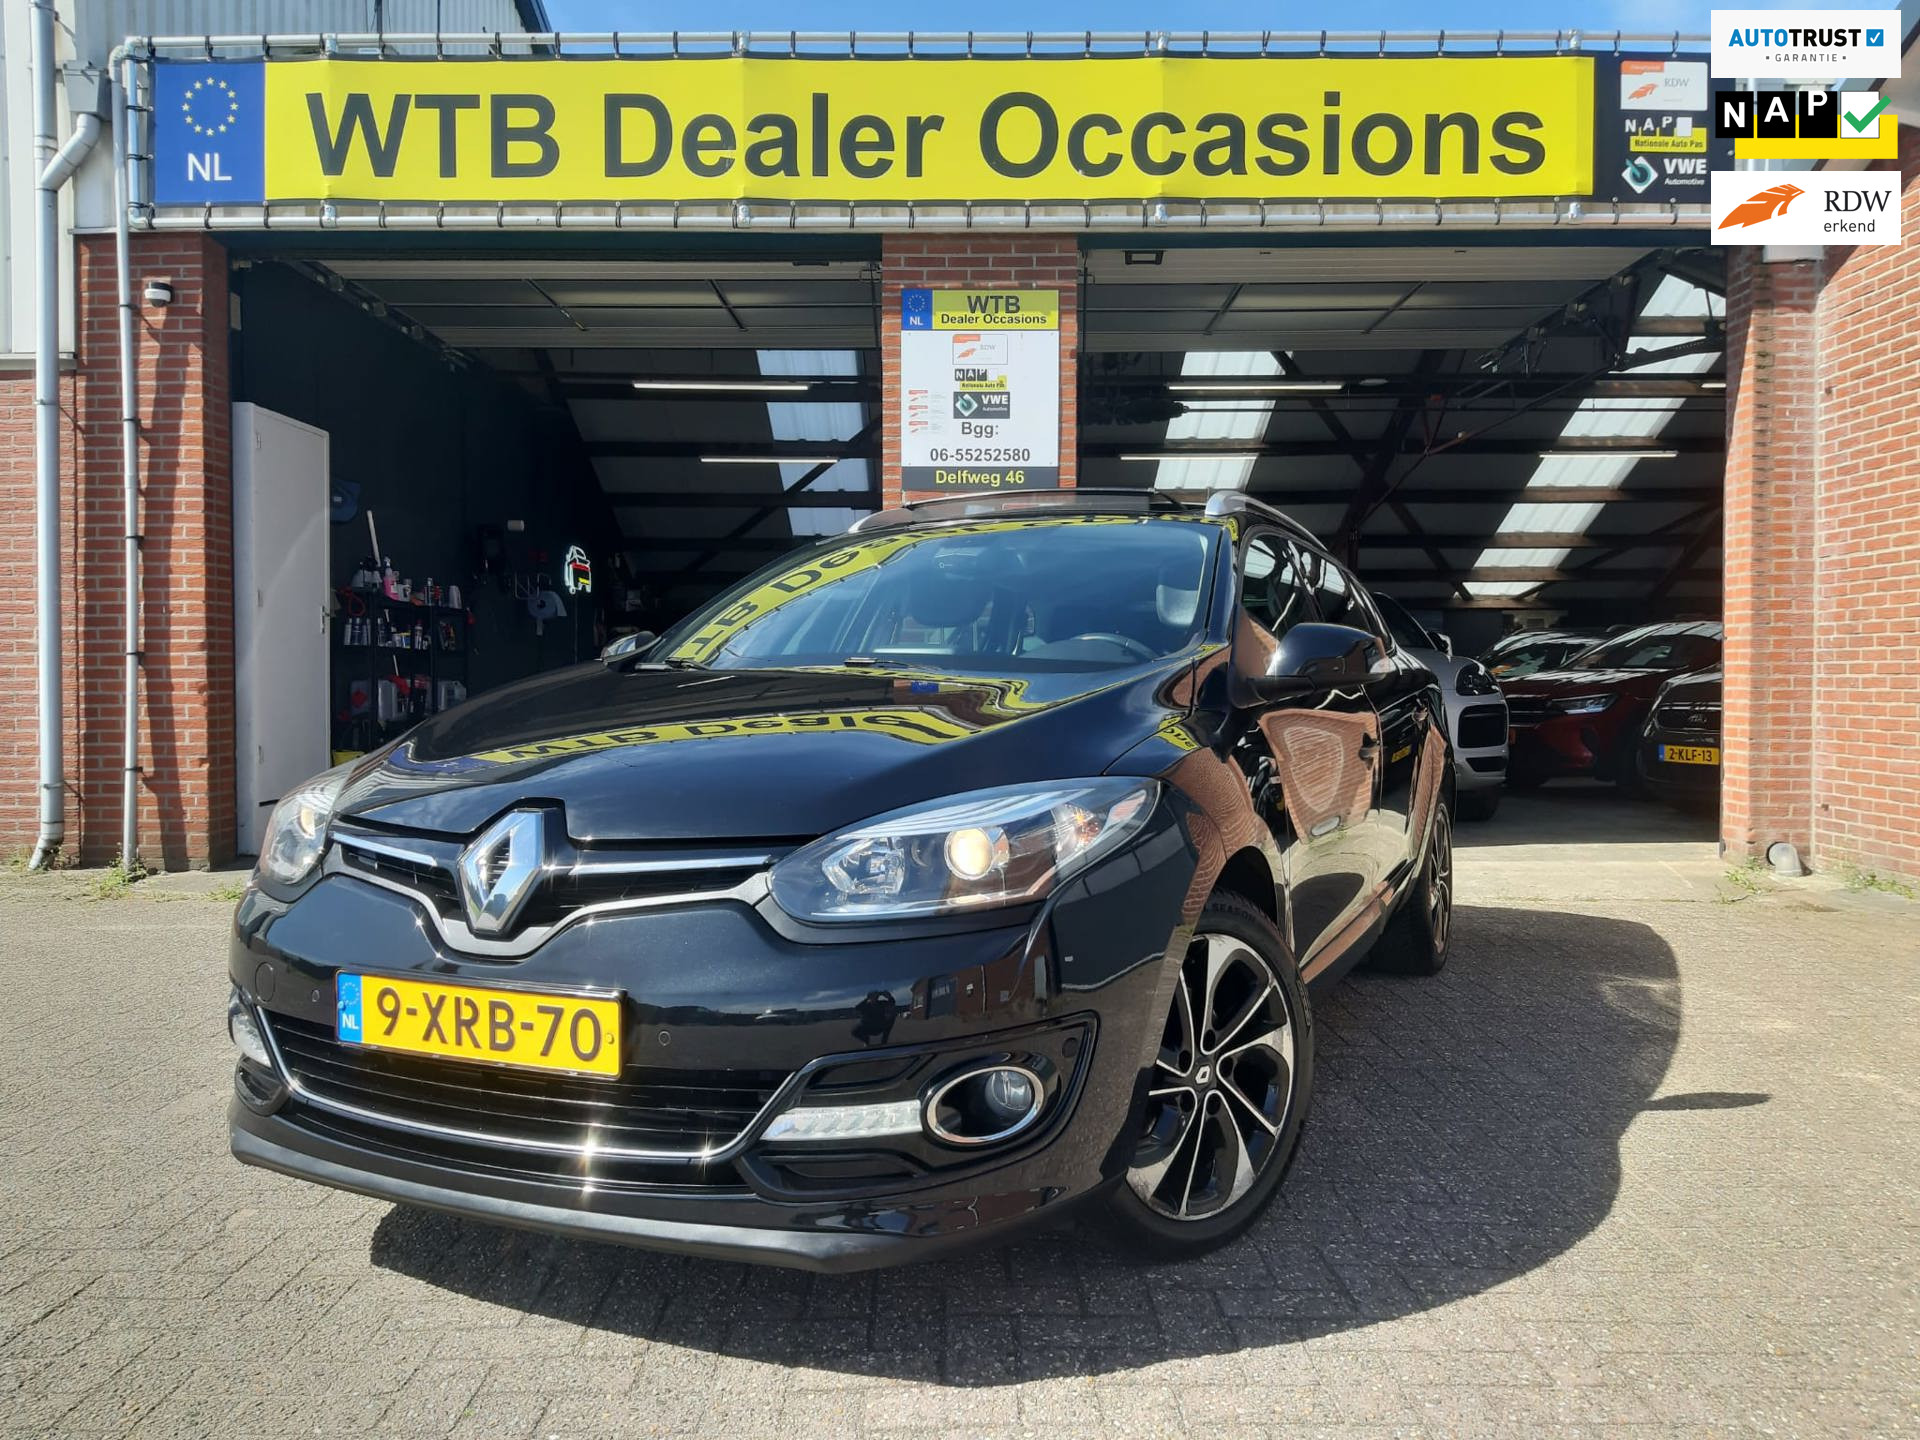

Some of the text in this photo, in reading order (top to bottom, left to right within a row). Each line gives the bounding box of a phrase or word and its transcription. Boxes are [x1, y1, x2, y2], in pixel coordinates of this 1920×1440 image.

[1664, 78, 1689, 88] RDW
[305, 91, 1546, 178] WTB Dealer Occasions
[1671, 139, 1688, 148] Auto
[1690, 139, 1704, 148] Pas
[188, 153, 232, 181] NL
[1663, 158, 1708, 174] VWE
[967, 295, 1020, 314] WTB
[909, 316, 923, 326] NL
[941, 314, 1047, 324] Dealer Occasions
[981, 394, 1009, 405] VWE
[961, 422, 999, 438] Bgg:
[930, 448, 1030, 462] 06-55252580
[936, 470, 1025, 486] Delfweg 46
[1670, 748, 1712, 762] 2-KLF-13
[342, 1013, 359, 1030] NL
[377, 987, 602, 1061] 9-XRB-70
